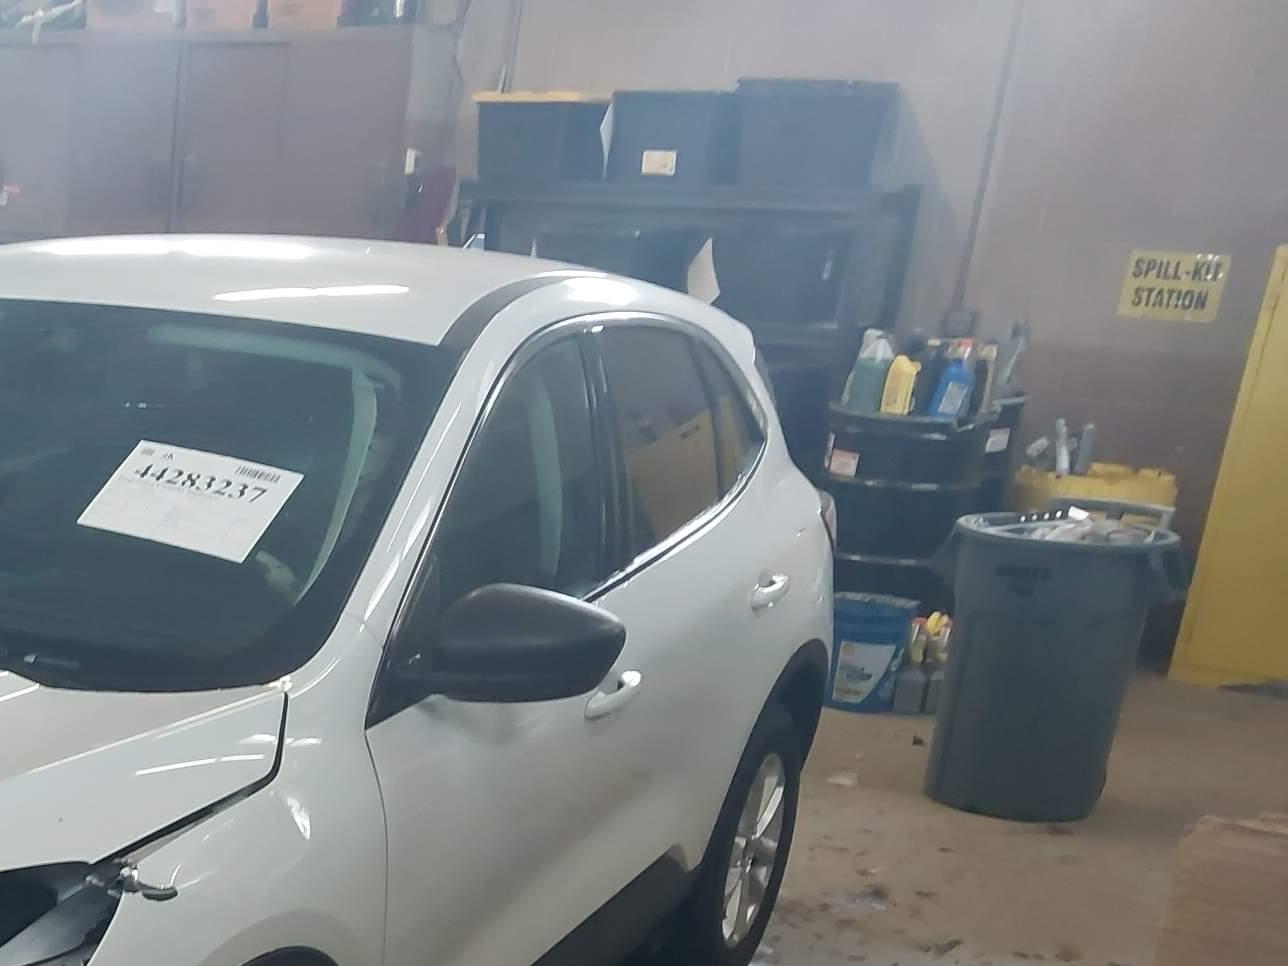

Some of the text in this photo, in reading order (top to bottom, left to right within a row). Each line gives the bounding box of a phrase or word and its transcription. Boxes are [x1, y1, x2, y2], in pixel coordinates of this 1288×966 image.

[1132, 257, 1223, 282] SPILL-KIT
[1131, 286, 1209, 311] STATION
[135, 463, 268, 503] 44283237
